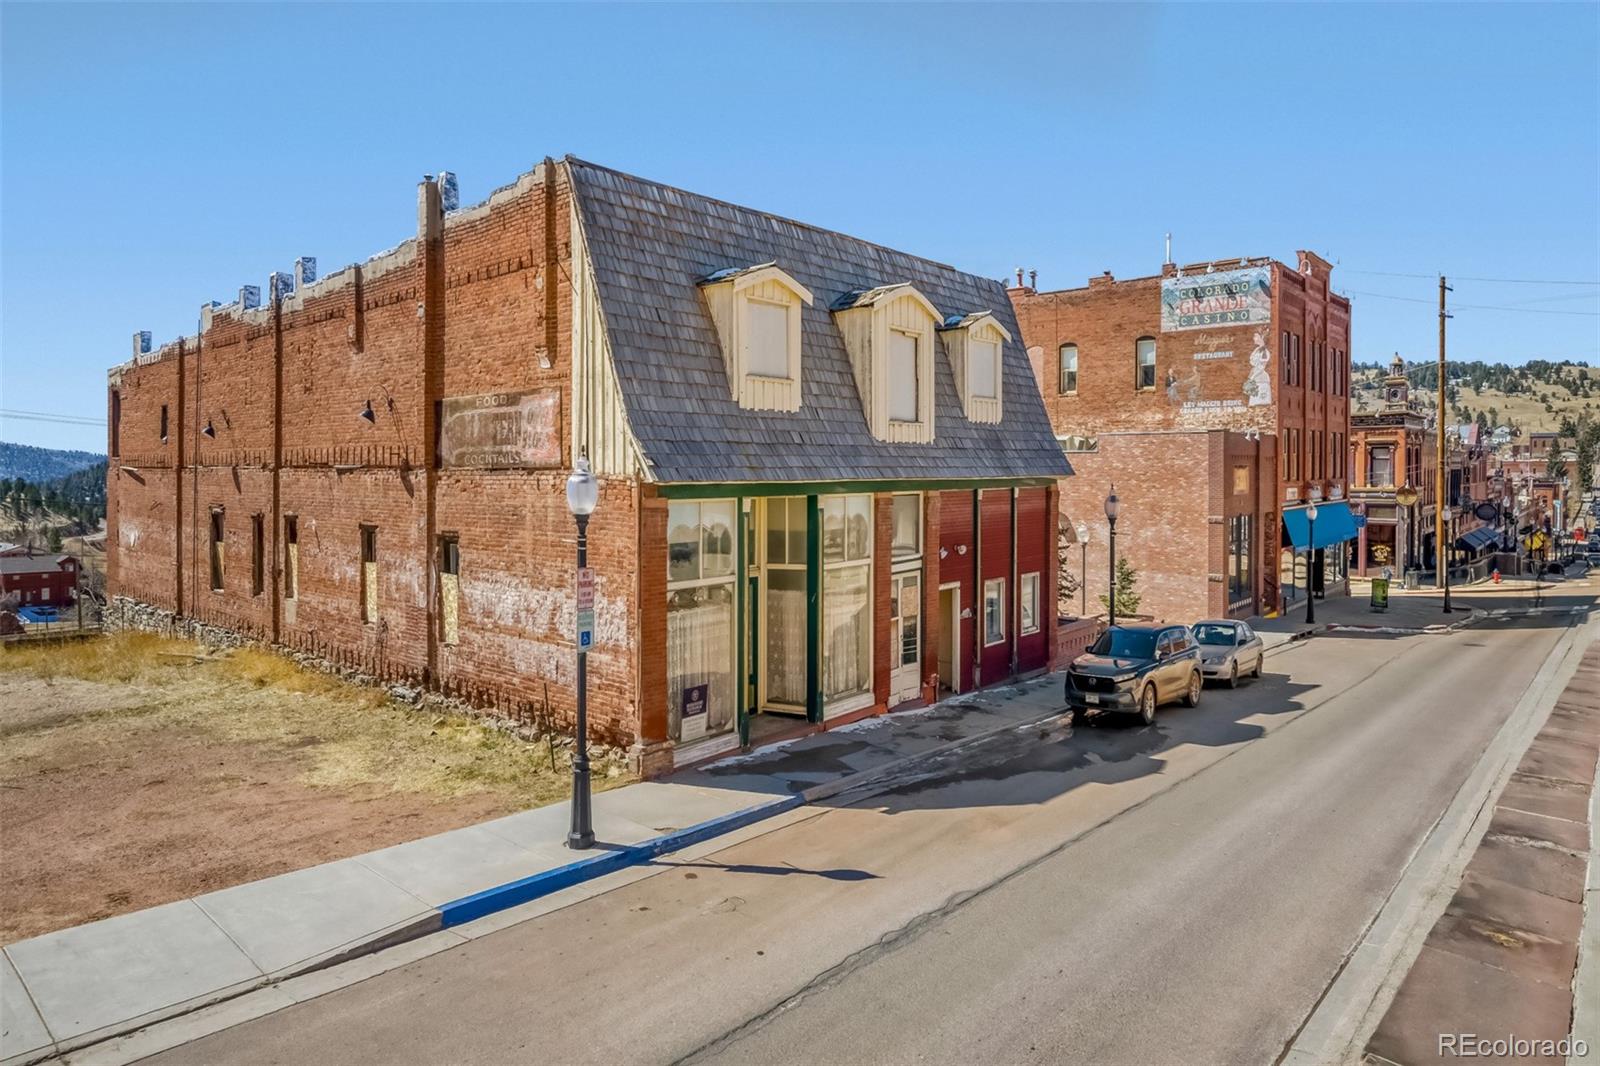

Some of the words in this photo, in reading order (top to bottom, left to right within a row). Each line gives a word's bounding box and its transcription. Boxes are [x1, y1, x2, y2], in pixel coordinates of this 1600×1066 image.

[1180, 282, 1249, 298] COLORADO
[1180, 295, 1248, 314] GRANDE
[1181, 311, 1248, 326] CASINO
[476, 395, 508, 407] FOOD
[464, 453, 520, 465] COCKTAILS
